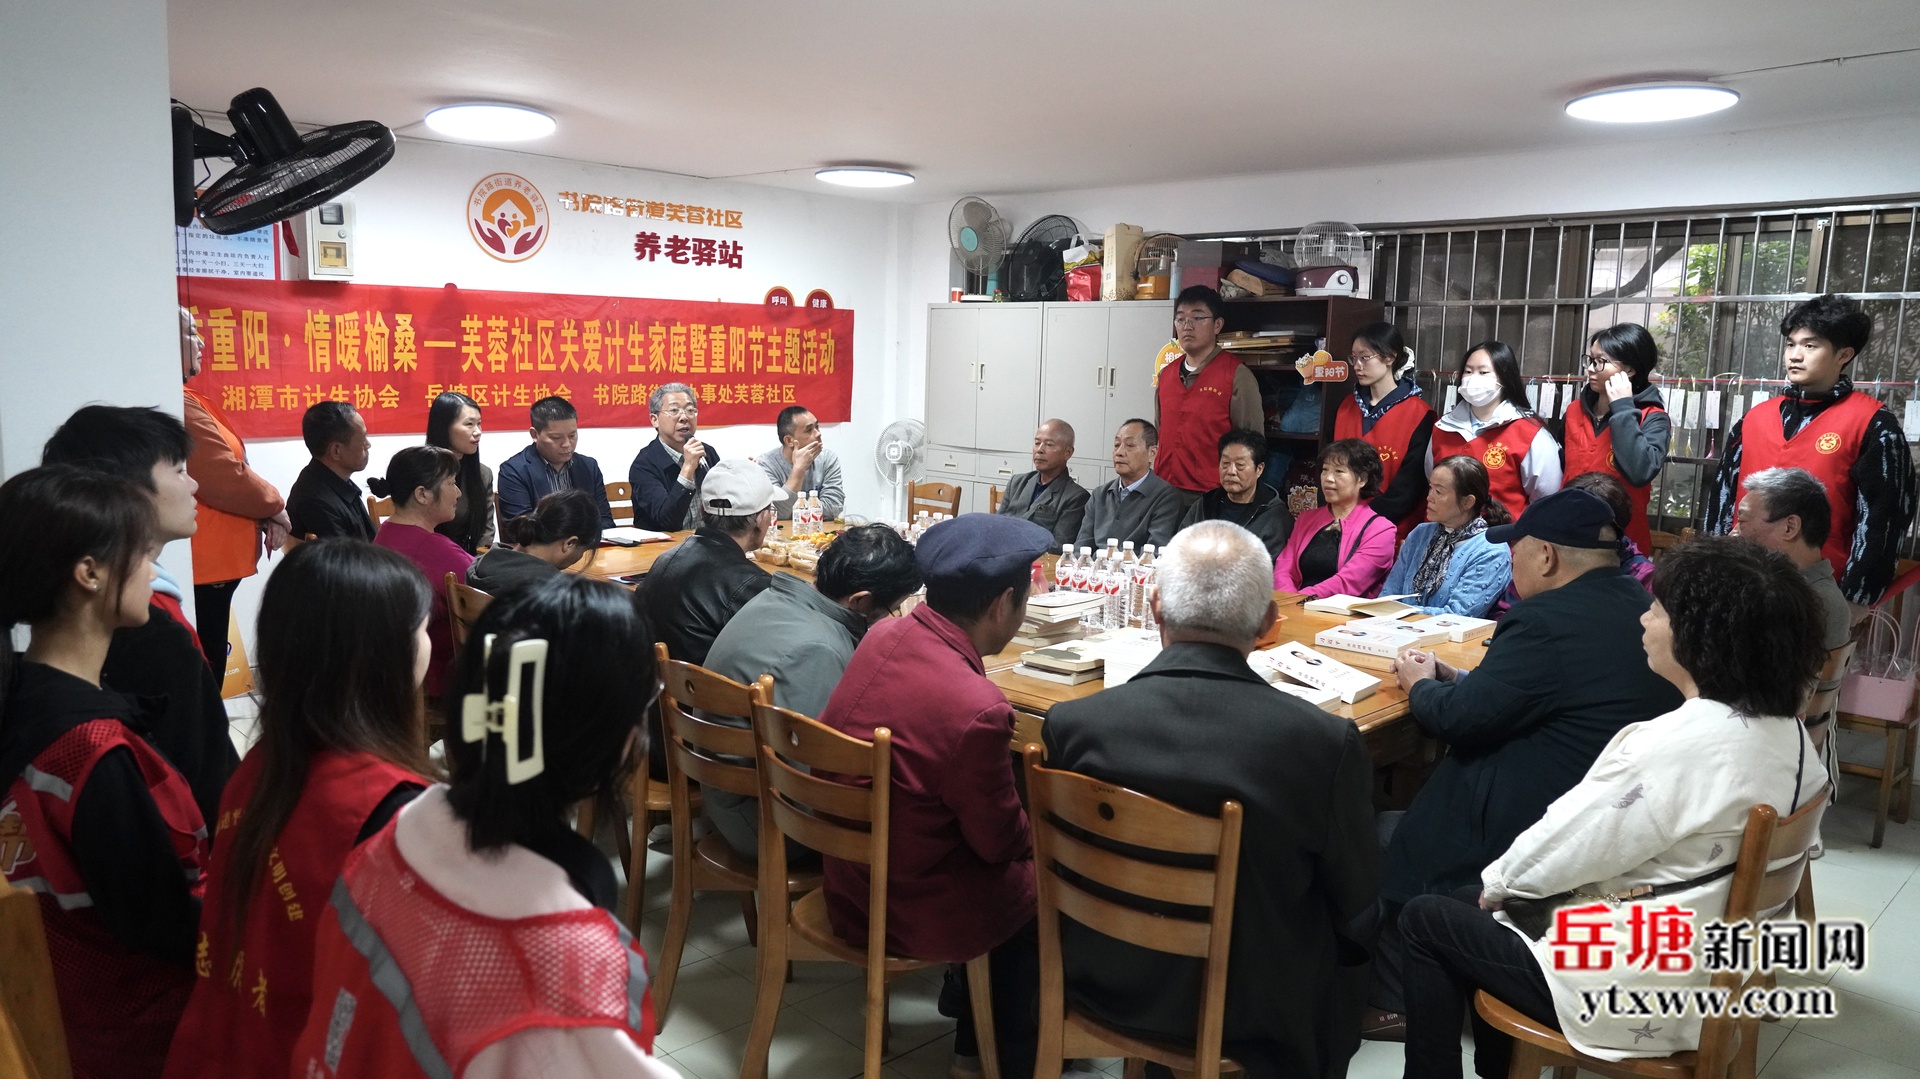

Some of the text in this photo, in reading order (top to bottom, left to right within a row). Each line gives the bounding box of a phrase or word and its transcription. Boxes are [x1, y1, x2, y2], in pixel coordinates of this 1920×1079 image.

[473, 177, 544, 213] 书院路街道养老驿站
[558, 191, 743, 229] 书院路街道芙蓉社区
[634, 231, 744, 269] 养老驿站
[771, 296, 788, 306] 呼叫
[812, 298, 828, 309] 健康
[1315, 366, 1345, 378] 重阳节
[593, 383, 796, 406] 书院路事处芙蓉社区
